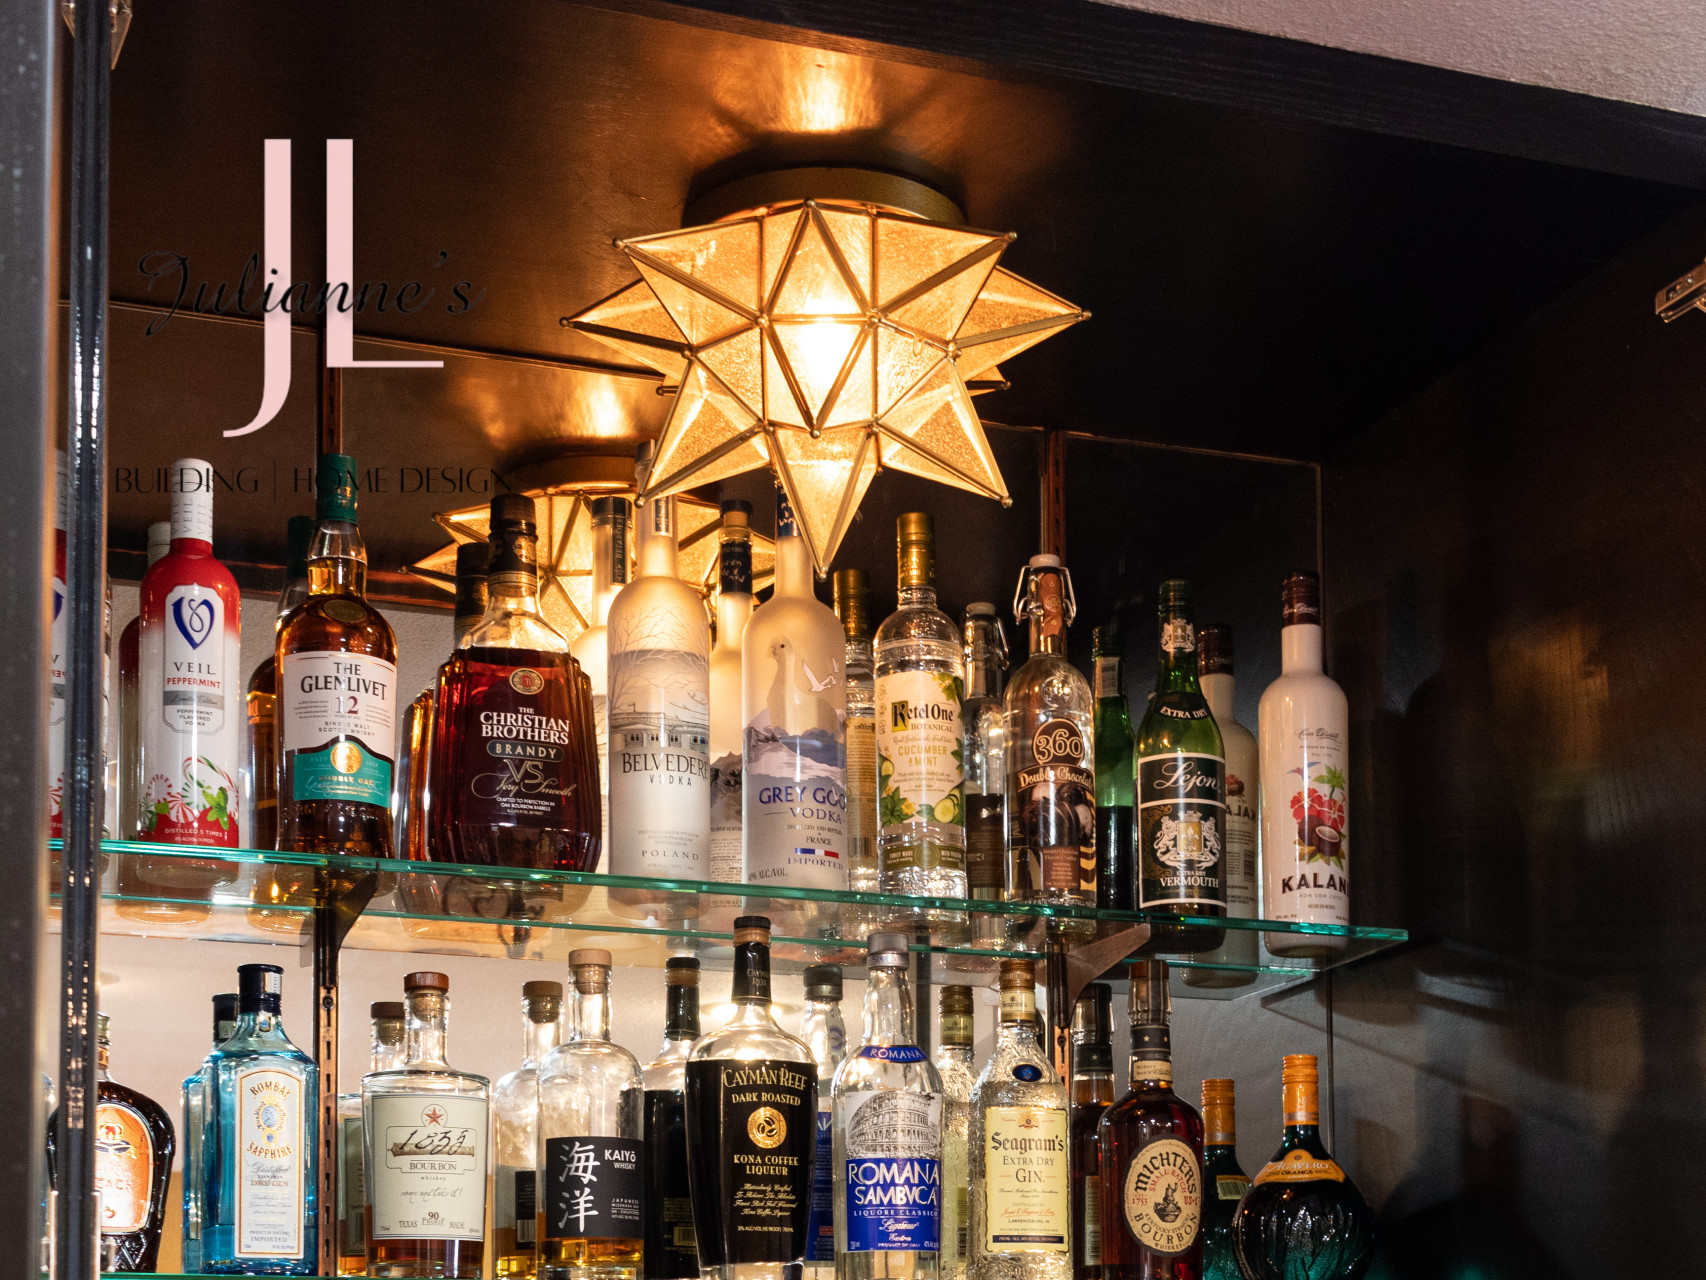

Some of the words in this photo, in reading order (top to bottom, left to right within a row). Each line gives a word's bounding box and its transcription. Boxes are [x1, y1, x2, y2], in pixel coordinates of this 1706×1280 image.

[173, 661, 214, 675] VEIL
[334, 662, 361, 676] THE
[166, 677, 221, 689] PEPPERMINT
[300, 675, 387, 701] GLENLIVET
[335, 695, 359, 715] 12
[518, 706, 535, 715] THE
[1159, 705, 1192, 719] EXTRA
[1192, 708, 1208, 718] DRY
[479, 710, 570, 733] CHRISTIAN
[892, 702, 930, 728] Ketel
[930, 703, 954, 722] One
[481, 724, 570, 745] BROTHERS
[911, 723, 953, 733] BOTANICAL
[495, 743, 557, 759] BRANDY
[898, 745, 948, 756] CUCUMBER
[1036, 728, 1084, 763] 360
[503, 759, 545, 783] VS
[1153, 760, 1218, 794] Lejon
[758, 785, 807, 804] GREY
[789, 807, 842, 825] VODKA
[805, 835, 832, 846] FRANCE
[641, 850, 699, 861] POLAND
[787, 857, 844, 870] IMPORTED
[1159, 876, 1220, 889] VERMOUTH
[869, 1047, 922, 1060] ROMANA
[723, 1068, 778, 1088] CAYMAN
[779, 1067, 808, 1092] REEF
[249, 1080, 293, 1100] BOMBAY
[731, 1092, 759, 1105] DARK
[761, 1092, 801, 1107] ROASTED
[991, 1131, 1065, 1154] Seagram's
[246, 1142, 294, 1160] SAPPHIRE
[409, 1162, 458, 1171] BOURBON
[613, 1161, 637, 1171] WHISKY
[733, 1154, 762, 1164] KONA
[765, 1154, 799, 1167] COFFEE
[1002, 1156, 1034, 1166] EXTRA
[1036, 1156, 1055, 1167] DRY
[746, 1165, 788, 1176] LIQUEUR
[848, 1160, 940, 1186] ROMANA
[1134, 1151, 1197, 1194] MICHTER'S
[250, 1179, 271, 1187] DRY
[271, 1180, 289, 1188] GIN
[558, 1141, 601, 1233] 海洋
[1149, 1168, 1170, 1193] SMALL
[1170, 1168, 1188, 1194] BATCH
[854, 1186, 937, 1206] SAMBVCA
[428, 1211, 440, 1221] 90
[853, 1208, 897, 1217] LIQUORE
[900, 1208, 939, 1217] CLASSICO
[398, 1220, 418, 1229] TEXAS
[421, 1216, 446, 1225] PROOF
[449, 1221, 465, 1230] MADE
[1134, 1212, 1198, 1245] BOURBON
[1145, 1212, 1170, 1234] KENTUCKY
[888, 1232, 912, 1242] Extra
